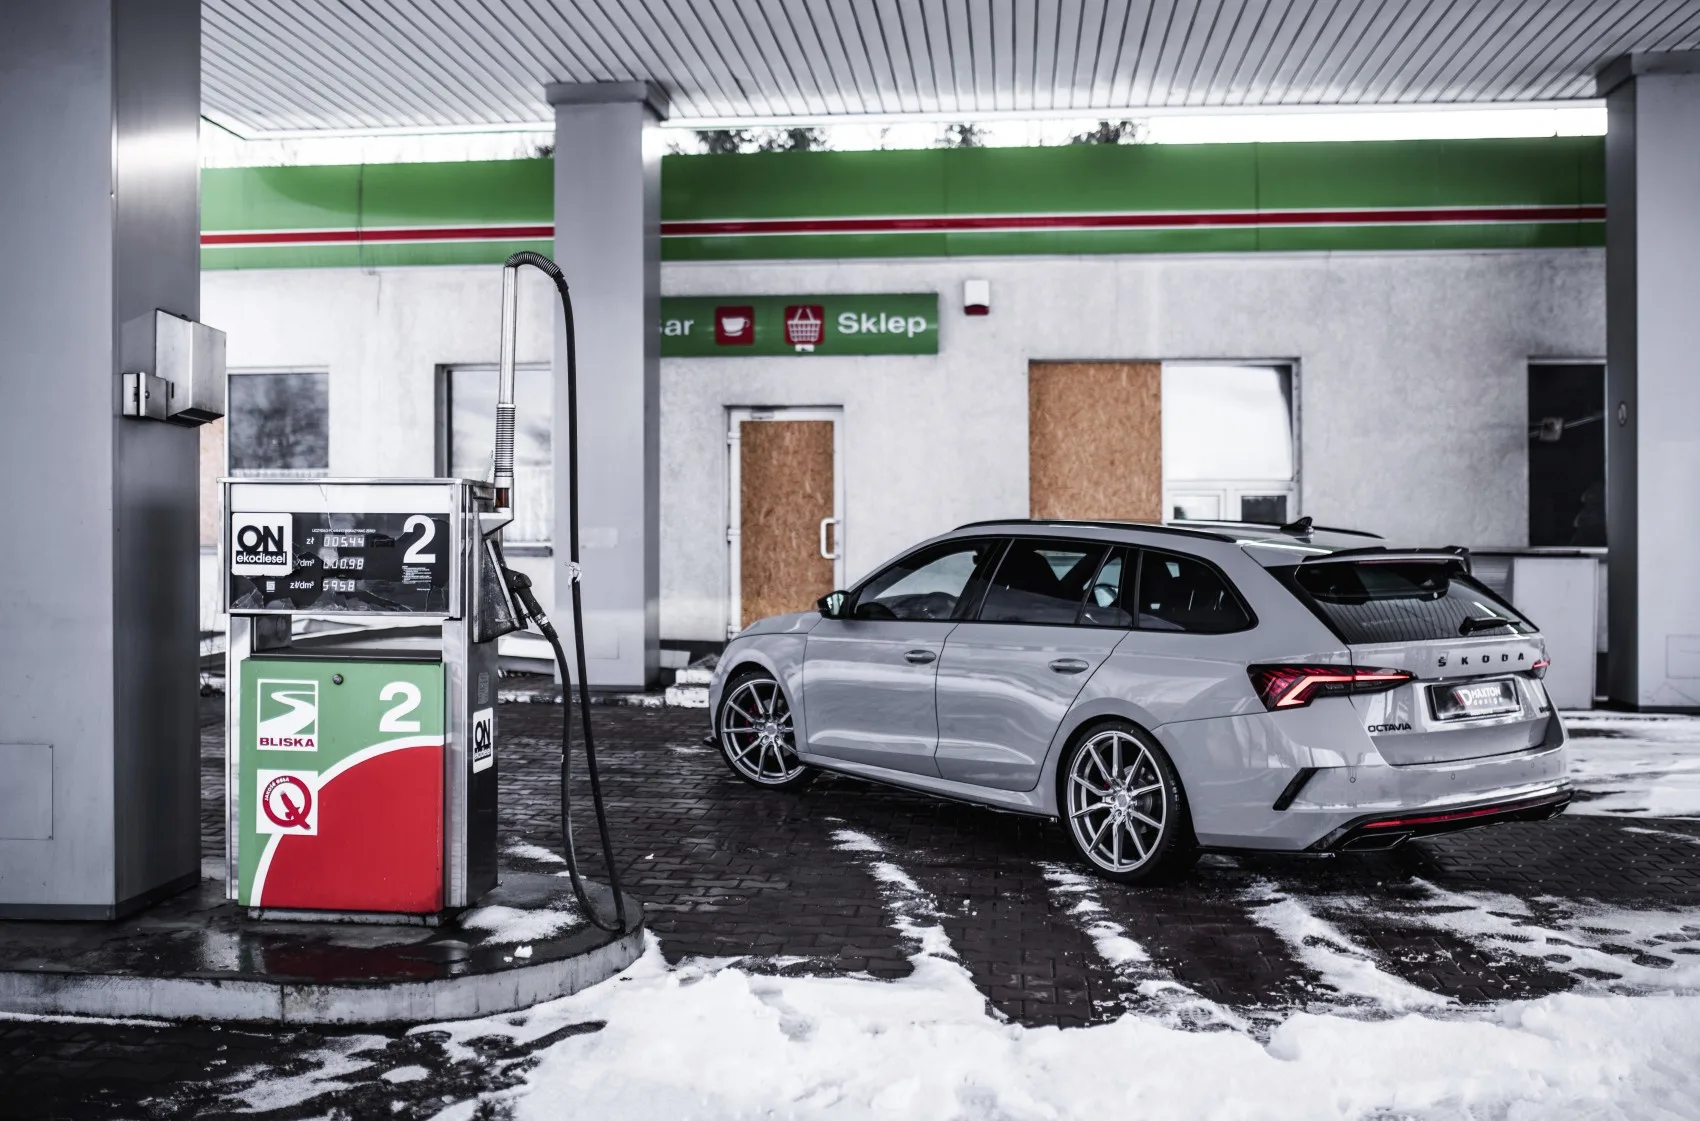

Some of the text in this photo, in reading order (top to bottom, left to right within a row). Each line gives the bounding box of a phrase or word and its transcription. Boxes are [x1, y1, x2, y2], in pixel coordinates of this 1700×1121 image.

[659, 319, 695, 336] ar
[837, 312, 927, 338] Sklep
[237, 525, 284, 552] ON
[403, 514, 436, 564] 2
[236, 551, 287, 564] ekodiesel
[1438, 652, 1525, 667] ŠKODA
[1471, 686, 1501, 699] MAXTON
[379, 681, 422, 732] 2
[474, 718, 491, 749] ON
[1367, 722, 1413, 733] OCTAVIA
[259, 737, 315, 748] BLISKA
